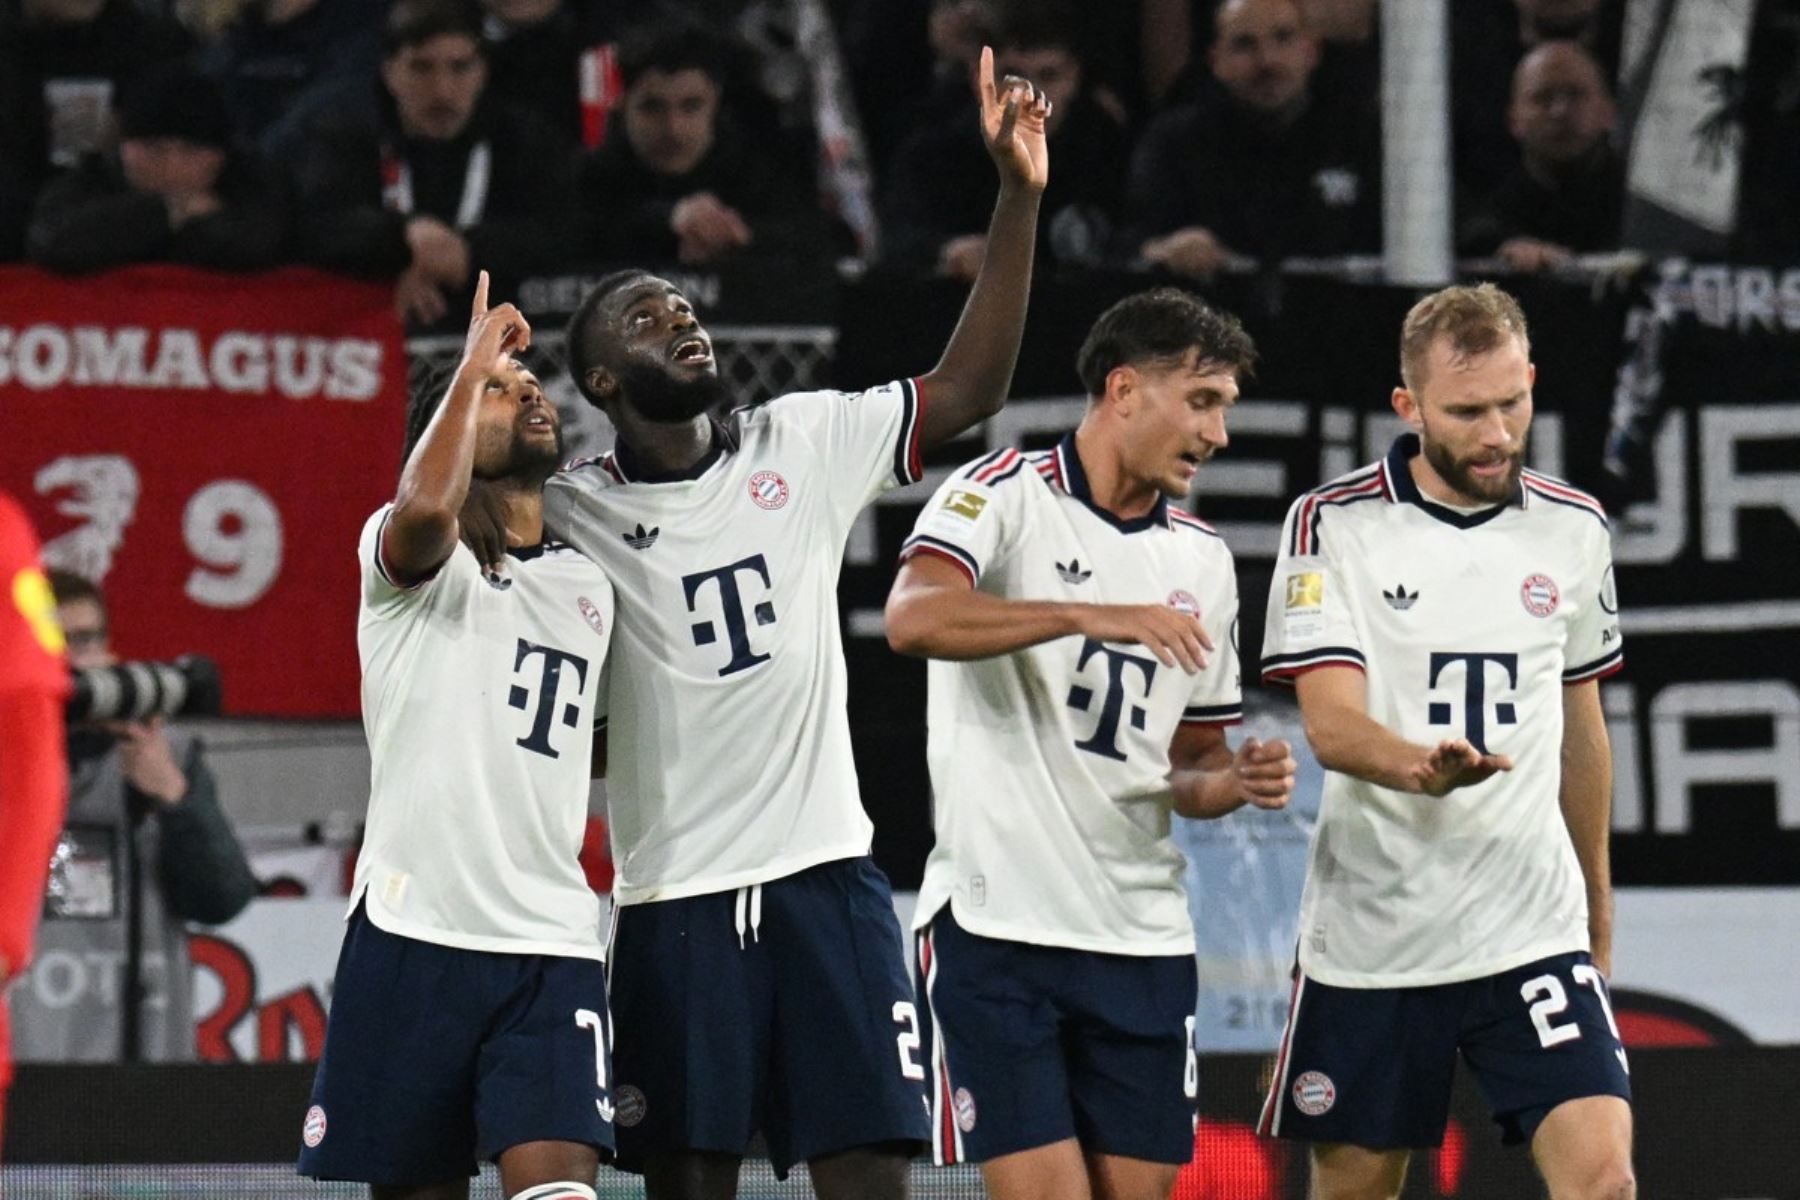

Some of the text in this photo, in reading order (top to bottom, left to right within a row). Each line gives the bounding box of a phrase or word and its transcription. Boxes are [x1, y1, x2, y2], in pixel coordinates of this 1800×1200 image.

[182, 479, 284, 609] 9
[682, 553, 776, 677] T
[508, 637, 588, 759] T
[1066, 638, 1158, 762] T
[1428, 651, 1518, 756] T
[575, 1008, 606, 1089] 7
[1520, 963, 1620, 1048] 27
